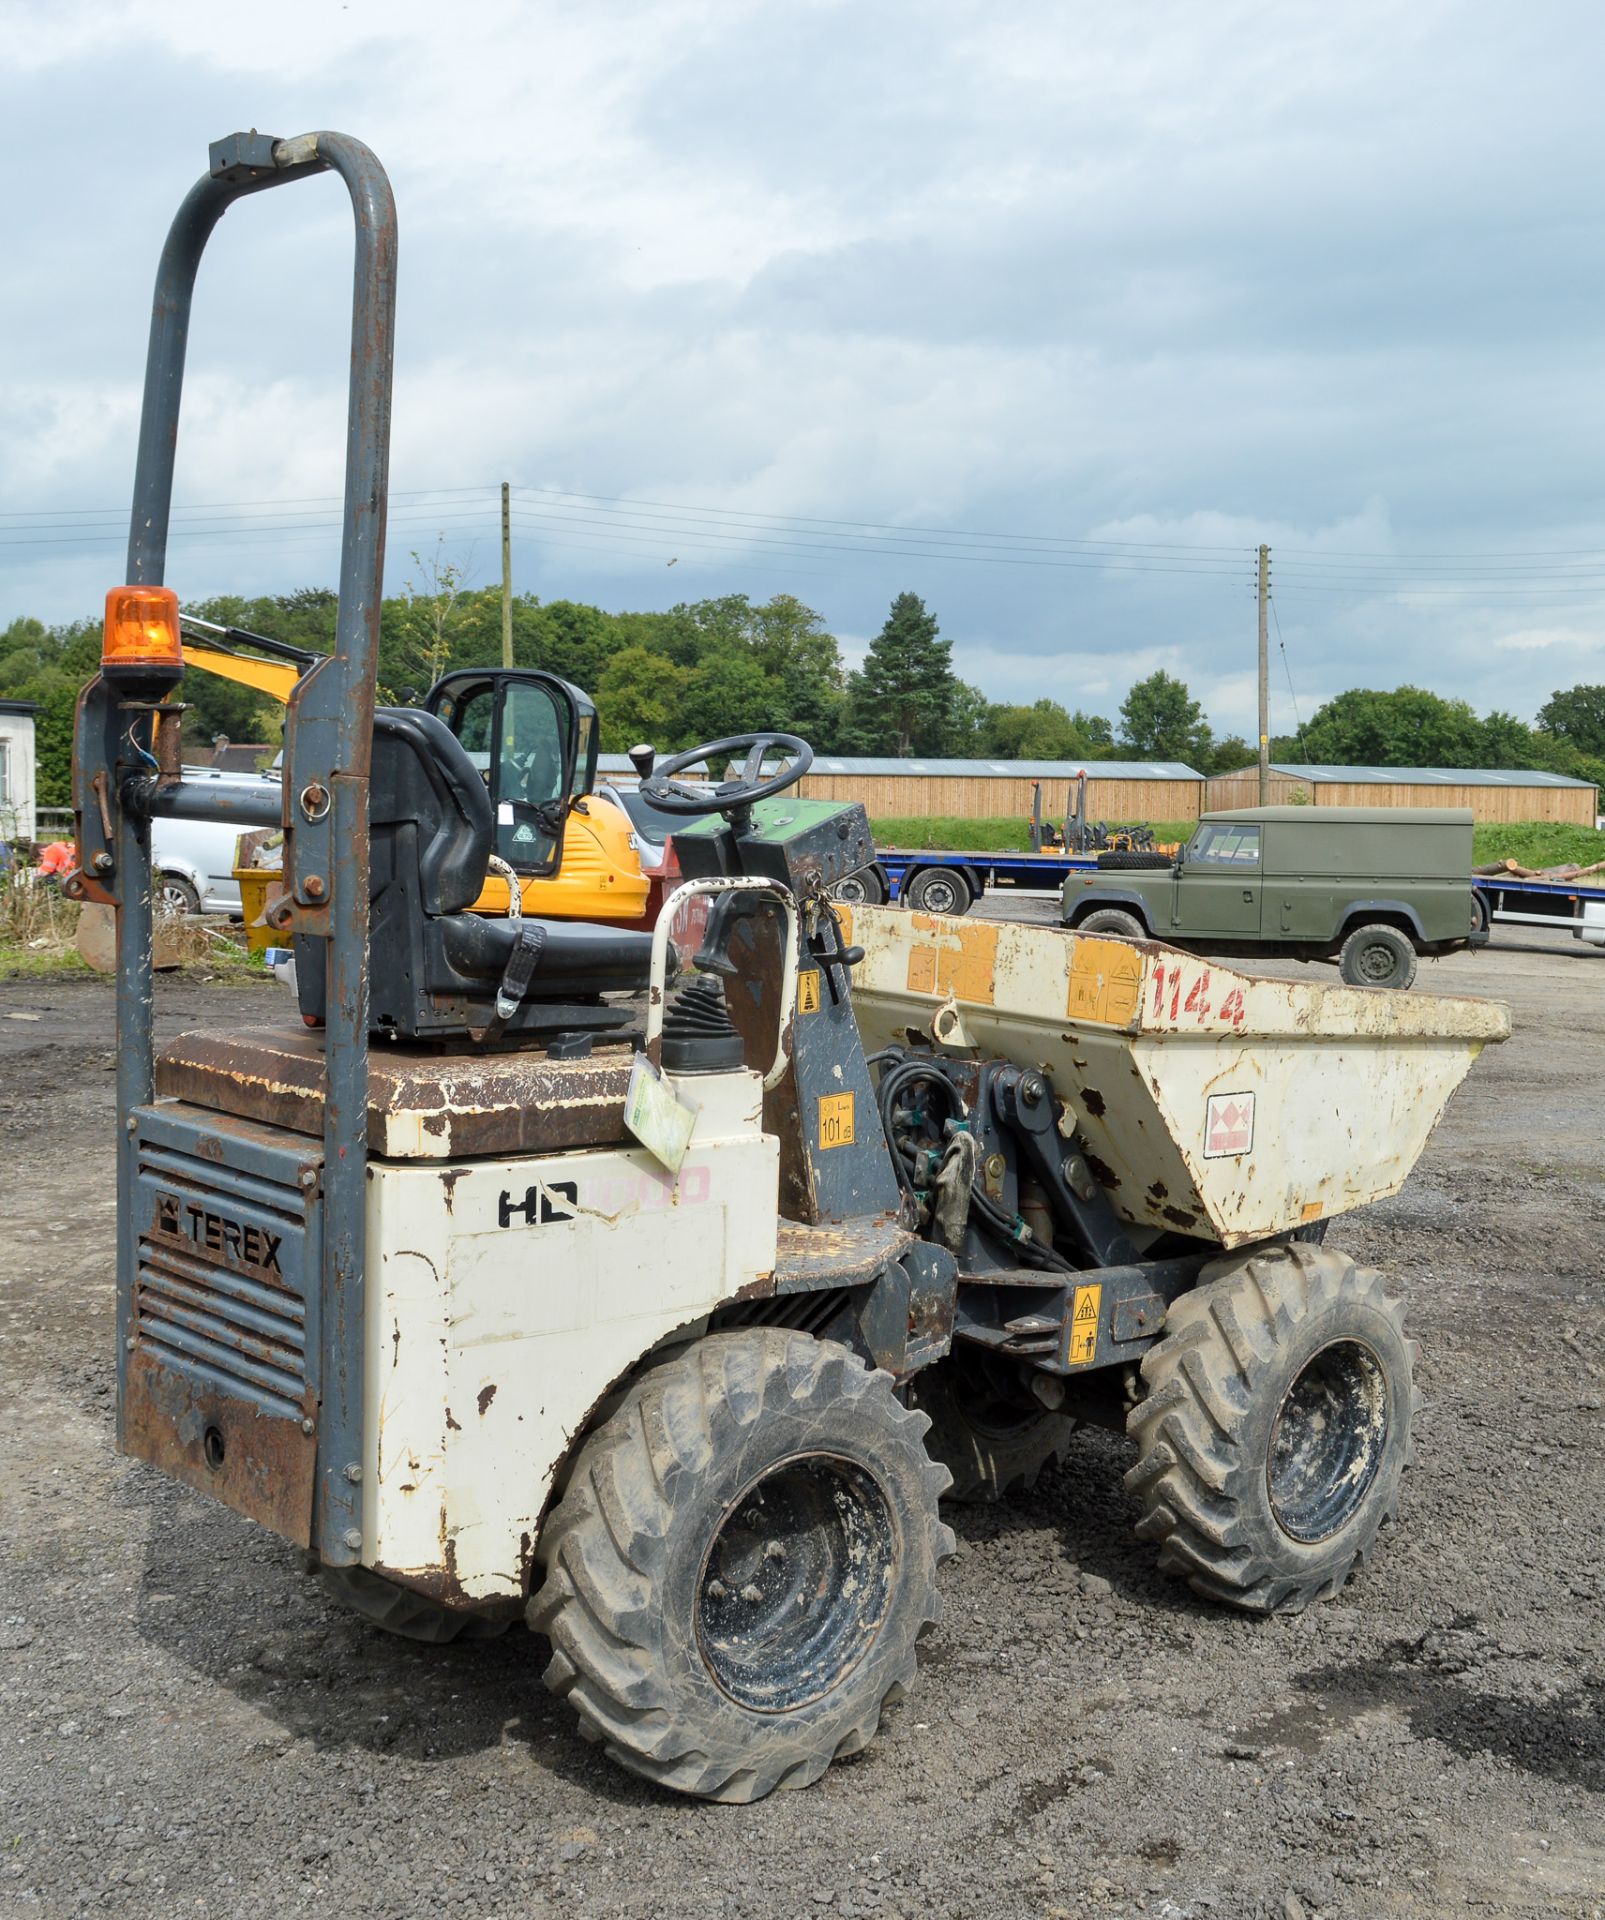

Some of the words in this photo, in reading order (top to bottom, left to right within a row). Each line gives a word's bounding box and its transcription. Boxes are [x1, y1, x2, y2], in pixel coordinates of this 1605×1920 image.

[1152, 965, 1245, 1025] 1144
[822, 1116, 840, 1141] 101
[186, 1204, 282, 1274] TEREX
